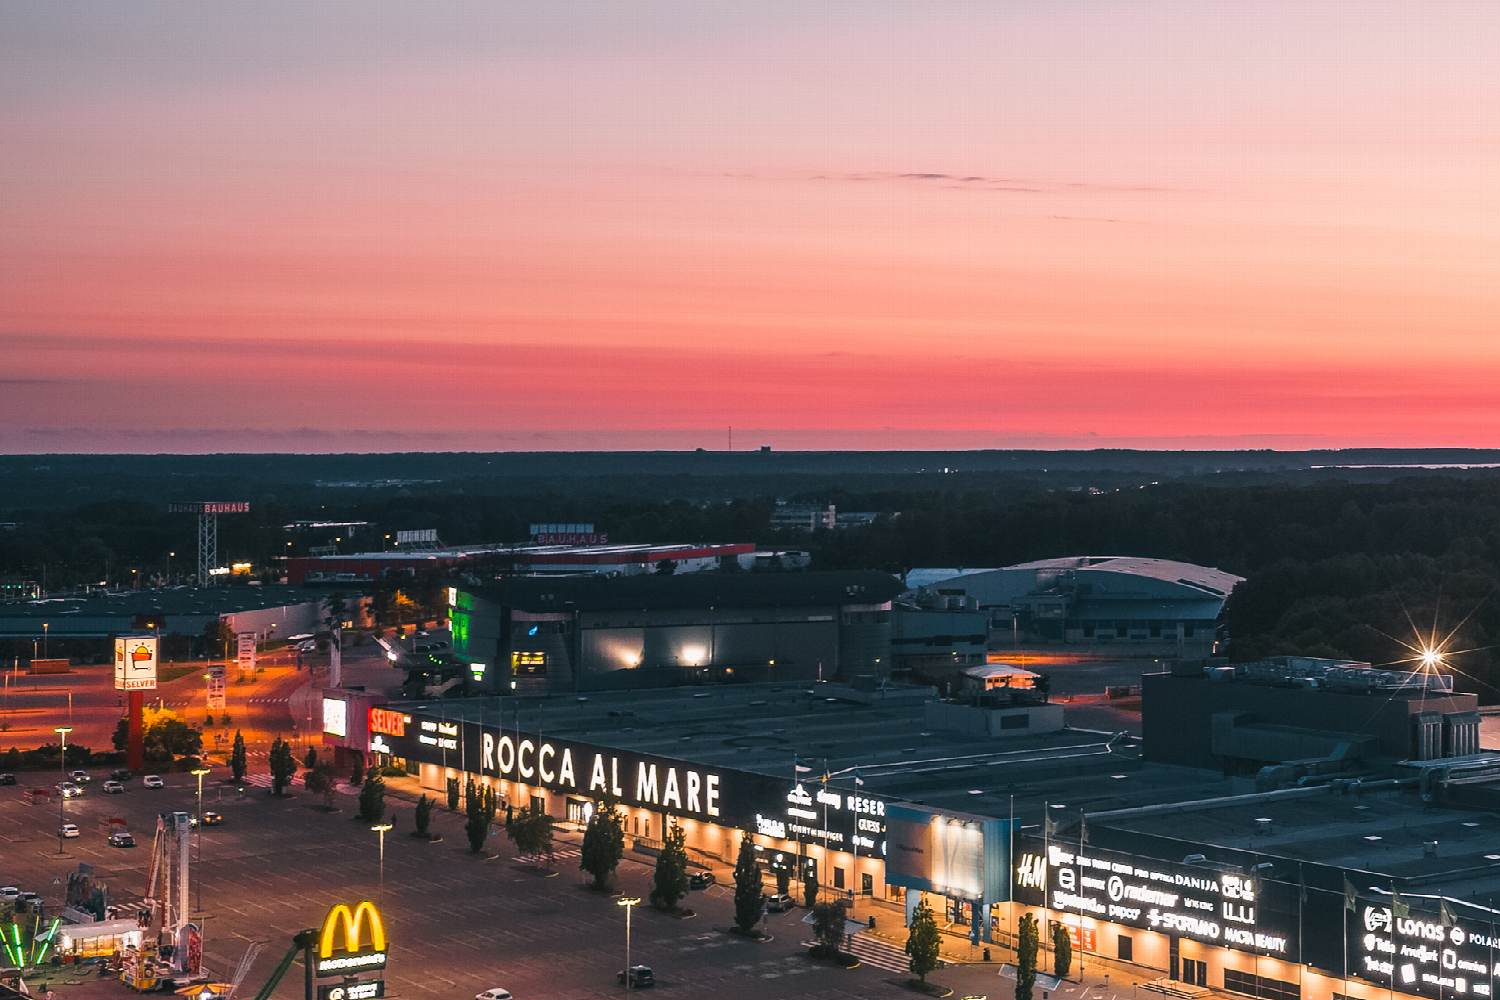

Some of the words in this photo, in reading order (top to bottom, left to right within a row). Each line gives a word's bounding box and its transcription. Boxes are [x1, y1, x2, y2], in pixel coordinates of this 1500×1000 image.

[204, 502, 250, 513] BAUHAUS
[537, 533, 609, 546] BAUHAUS
[126, 679, 156, 689] SELVER
[371, 707, 405, 737] SELVER
[482, 732, 576, 788] ROCCA
[589, 753, 623, 797] AL
[636, 761, 721, 817] MARE
[1017, 853, 1048, 892] H&M
[1175, 874, 1220, 893] DANIJA
